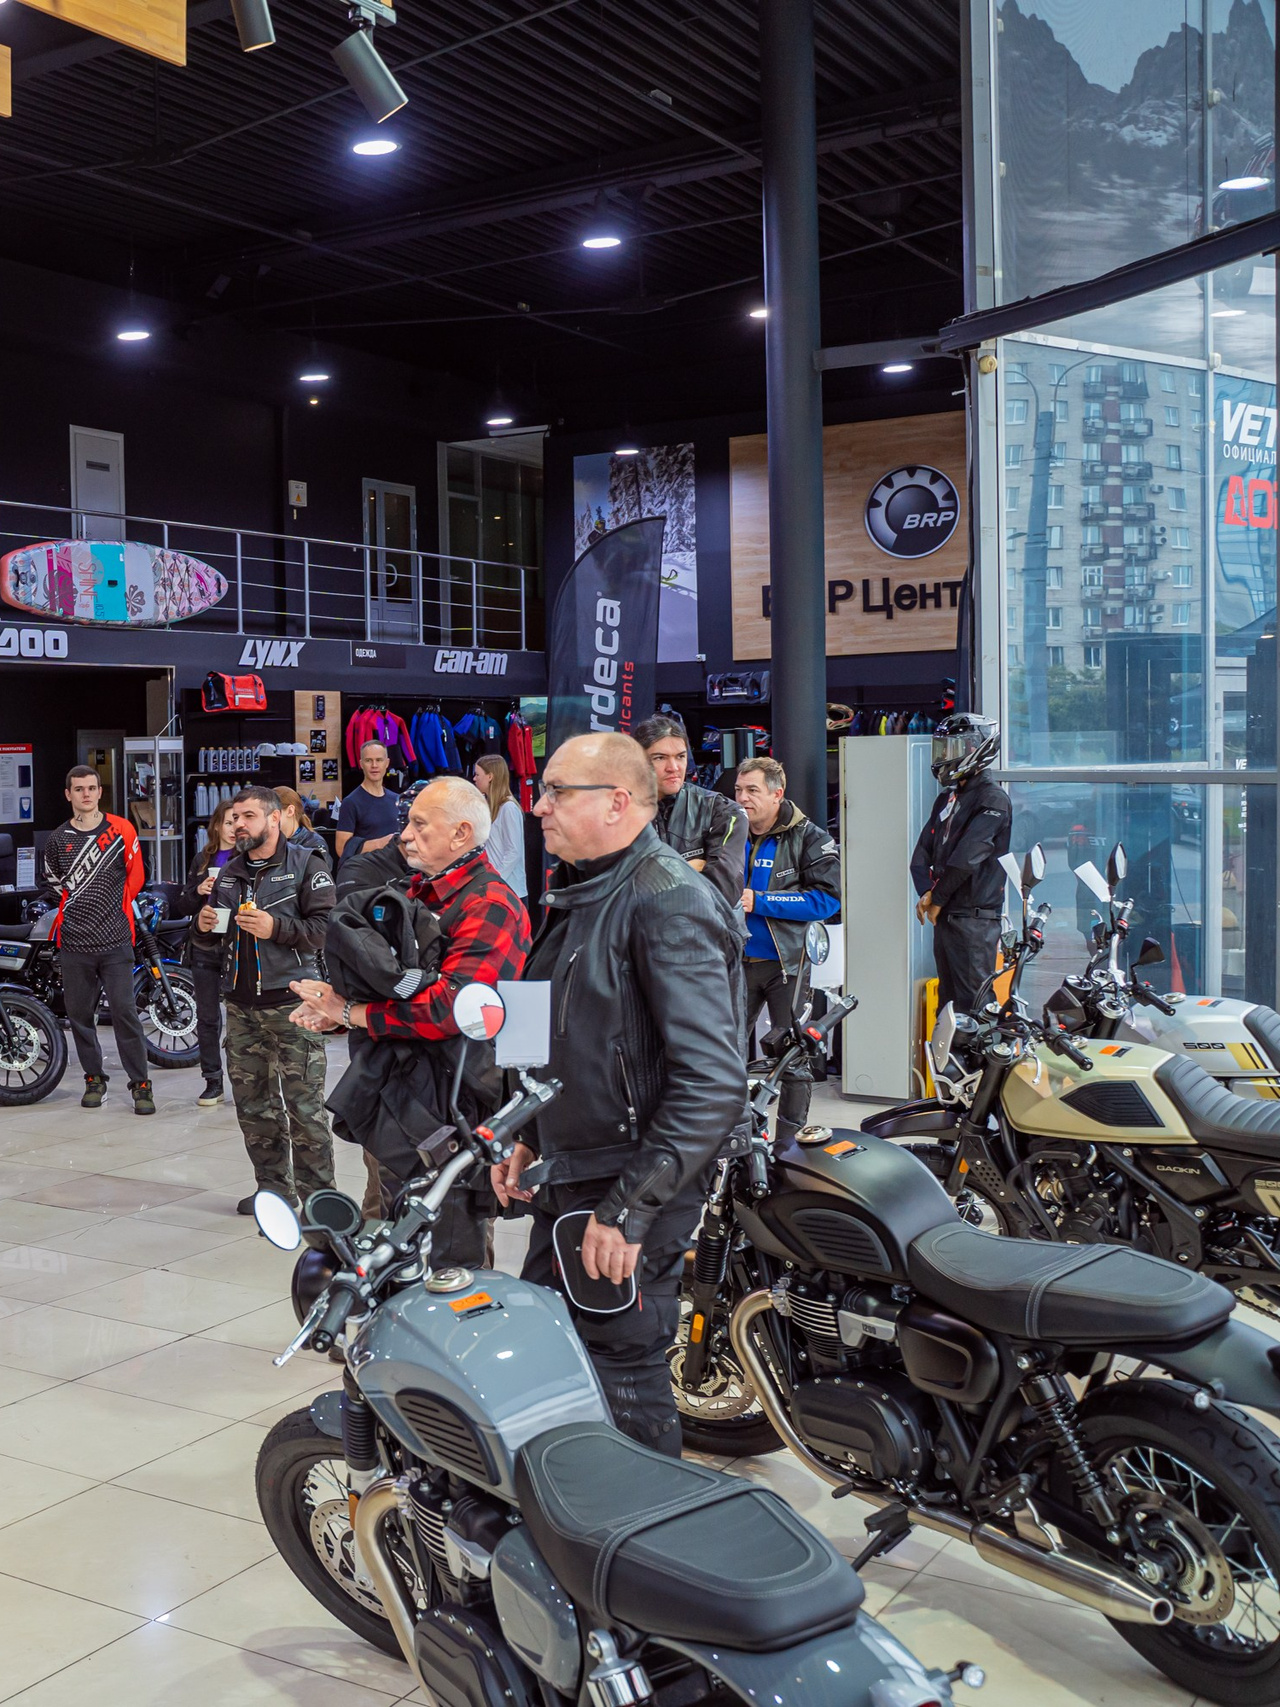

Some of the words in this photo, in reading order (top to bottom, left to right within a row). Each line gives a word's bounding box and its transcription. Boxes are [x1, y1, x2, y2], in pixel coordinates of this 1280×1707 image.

[903, 511, 955, 529] BRP
[238, 639, 305, 669] LYNX
[355, 648, 377, 658] ОДЕЖДА
[767, 895, 806, 903] HONDA
[1183, 1042, 1226, 1050] 500
